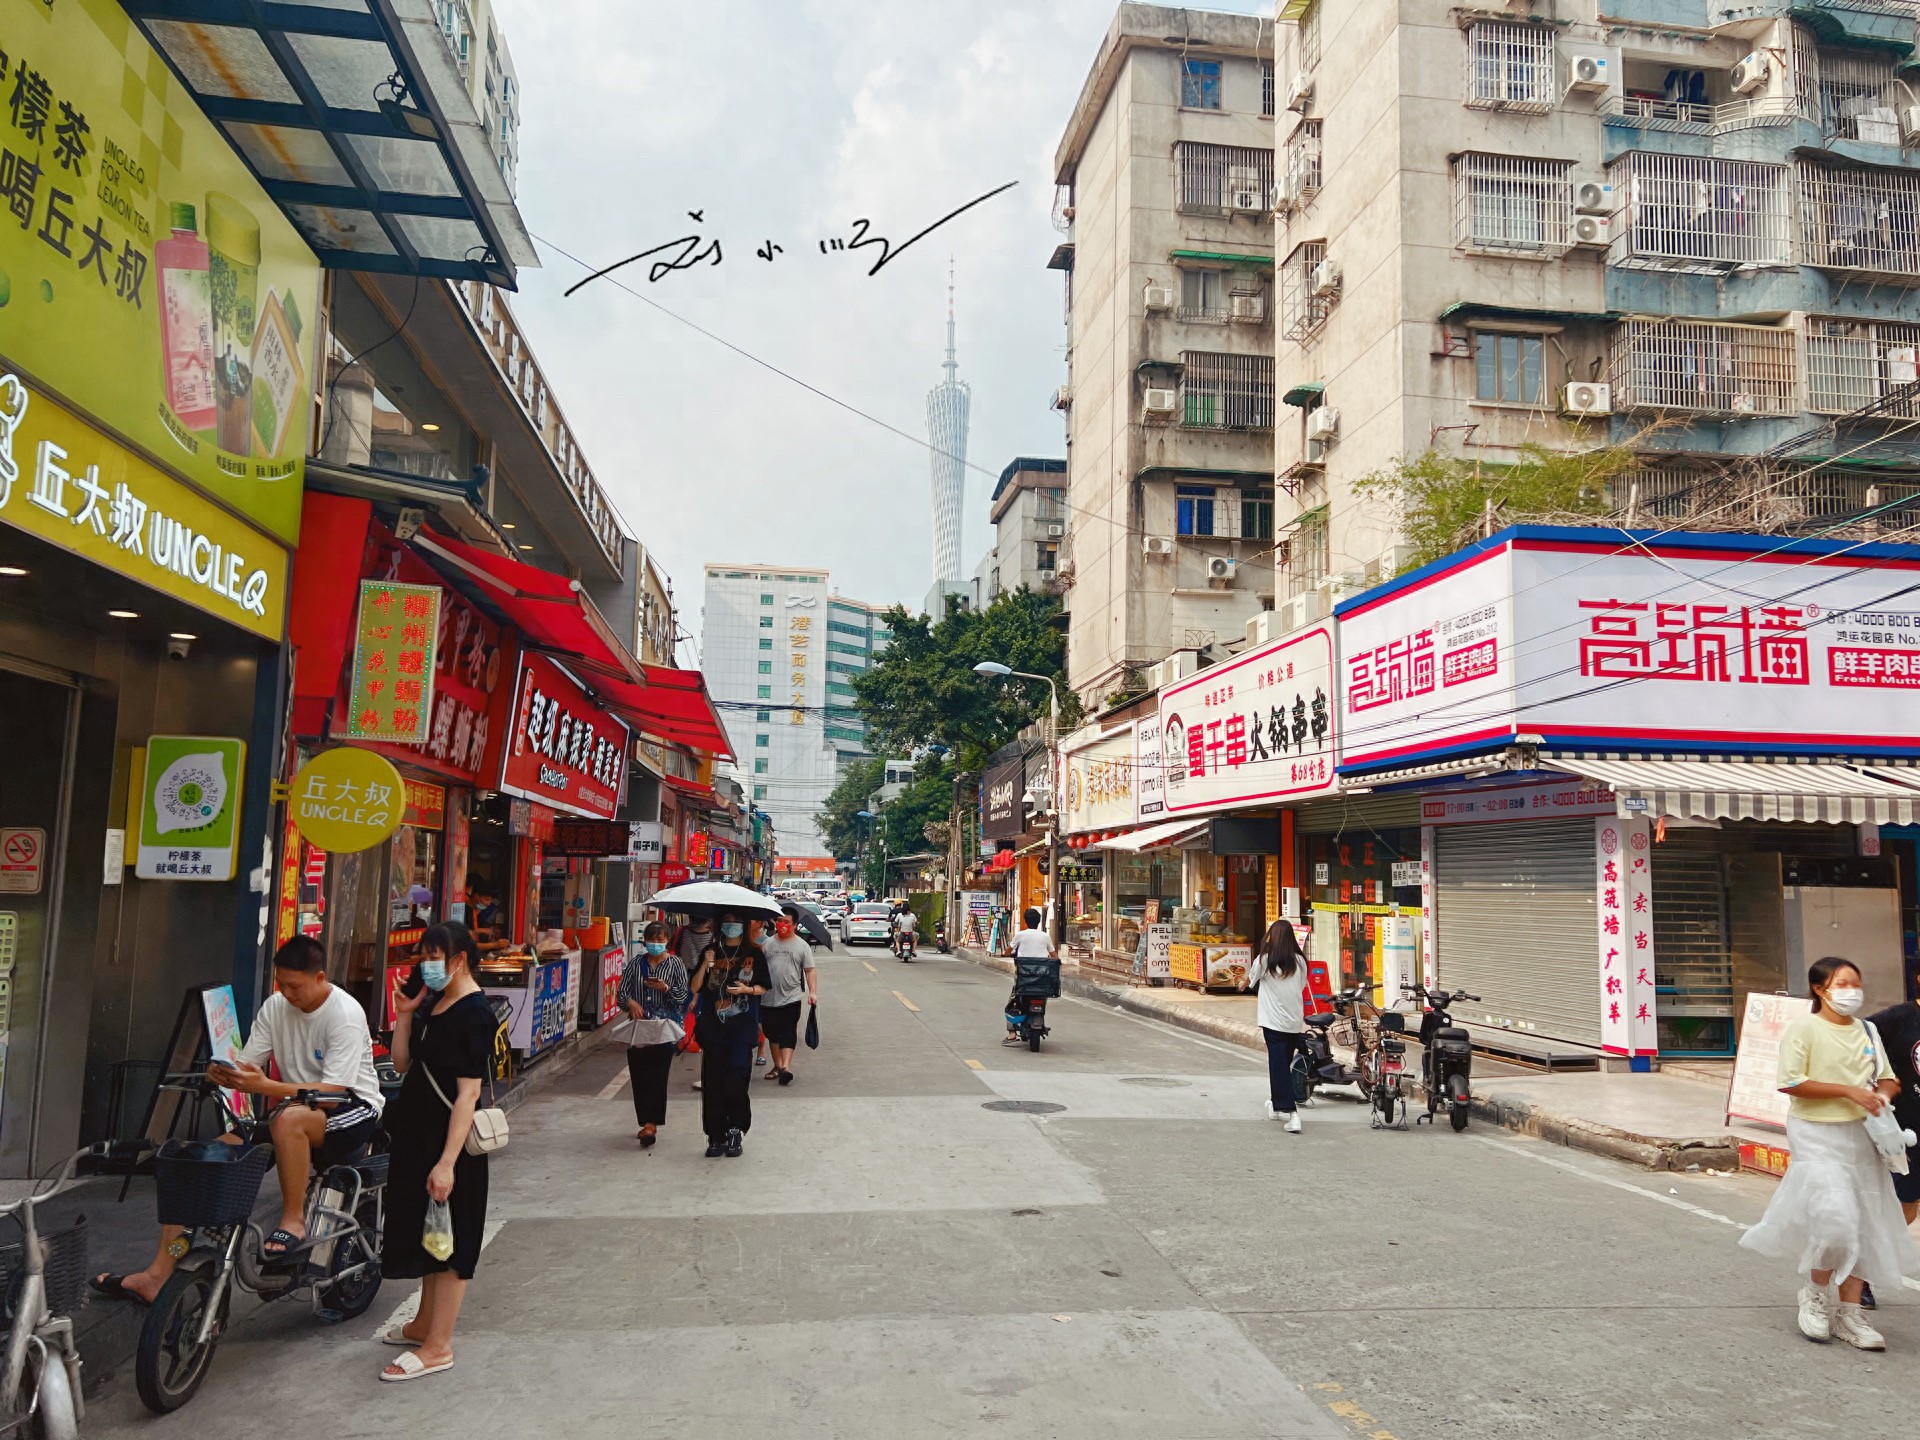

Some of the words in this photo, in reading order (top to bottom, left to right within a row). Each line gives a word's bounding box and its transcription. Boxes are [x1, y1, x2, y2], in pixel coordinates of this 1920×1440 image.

[101, 159, 120, 187] FOR
[97, 181, 132, 222] LEMON
[133, 210, 150, 237] TEA
[26, 440, 148, 556] 丘大叔
[1836, 630, 1895, 644] 鸿运花园店
[1898, 633, 1919, 645] No.
[393, 591, 431, 734] 柳州螺蛳粉
[789, 616, 812, 726] 港艺商务大厦
[1444, 643, 1495, 676] 鲜羊肉串
[1445, 673, 1466, 685] Fresh
[1466, 665, 1496, 679] Mutton
[1834, 674, 1876, 684] Fresh
[1290, 756, 1326, 784] 第68分店
[301, 775, 393, 808] 丘大叔
[168, 850, 202, 862] 柠檬茶
[633, 840, 660, 852] 椰子鸡
[155, 862, 212, 875] 就喝丘大叔
[1631, 858, 1654, 1025] 只卖当天羊
